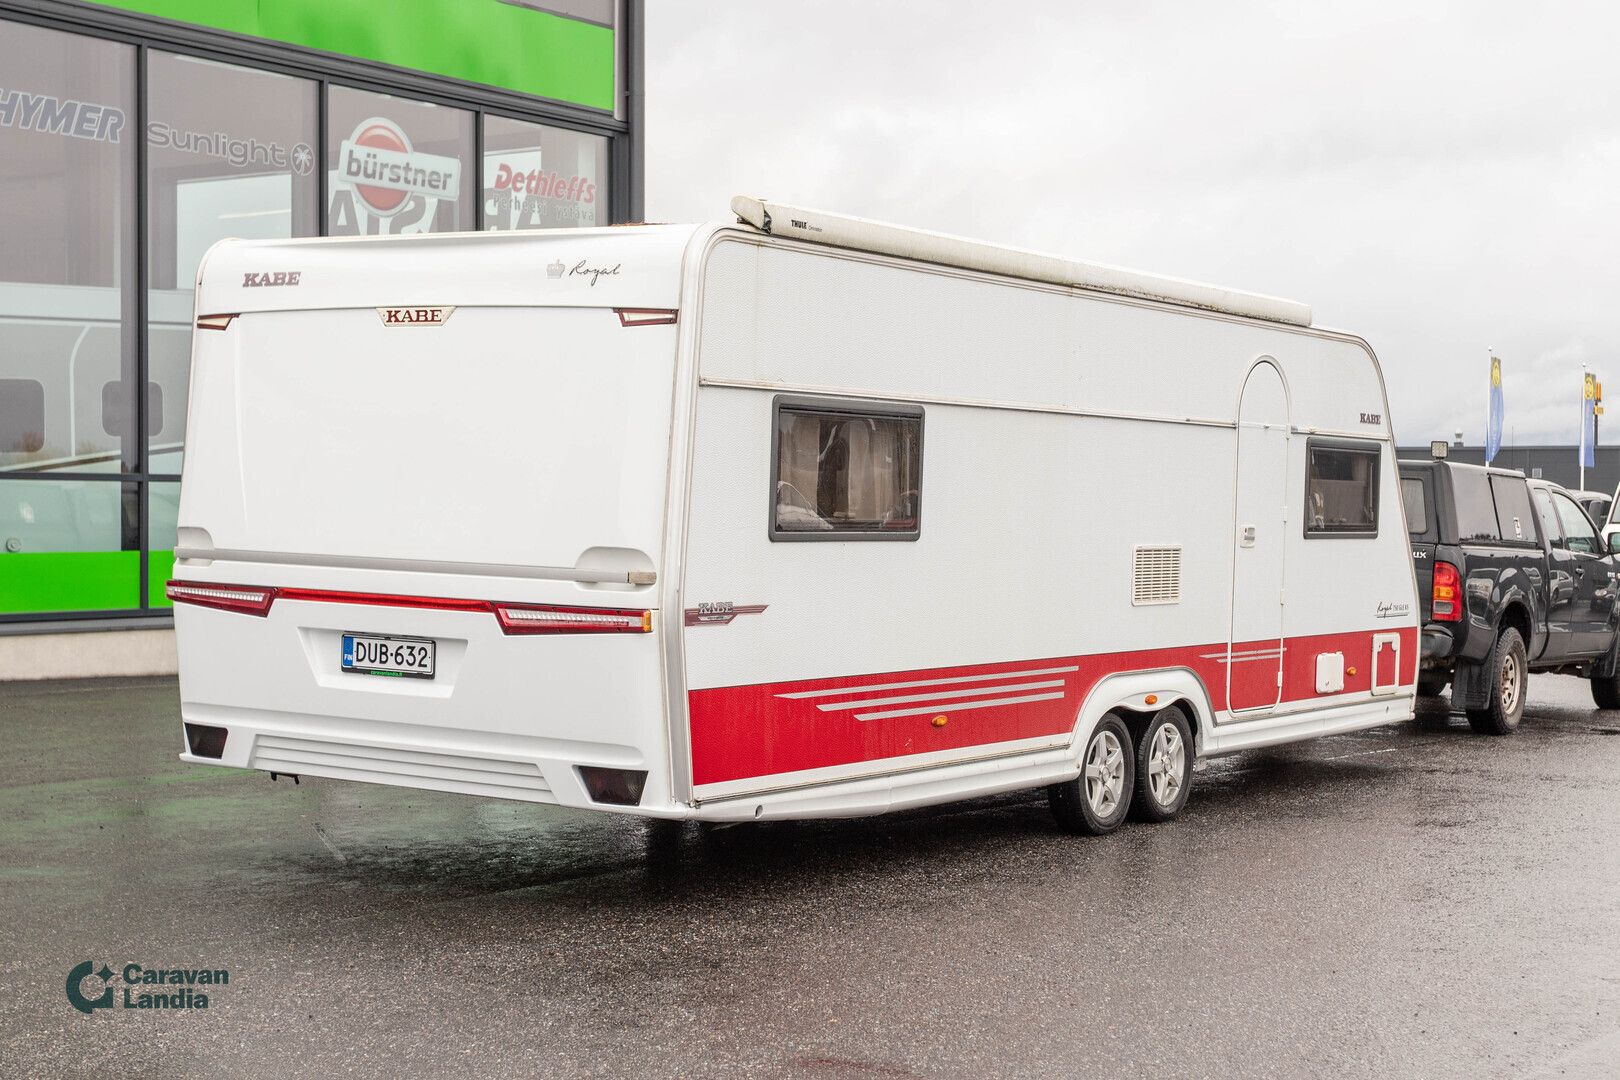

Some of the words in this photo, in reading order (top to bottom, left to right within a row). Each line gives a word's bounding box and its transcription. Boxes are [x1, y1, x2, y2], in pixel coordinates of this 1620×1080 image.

[147, 121, 287, 167] Sunlight
[346, 149, 453, 191] bürstner
[495, 163, 596, 203] Dethleffs
[791, 219, 807, 230] THULE
[243, 271, 301, 288] KABE
[569, 259, 621, 287] Royal
[386, 309, 442, 323] KABE
[1360, 412, 1381, 425] KABE
